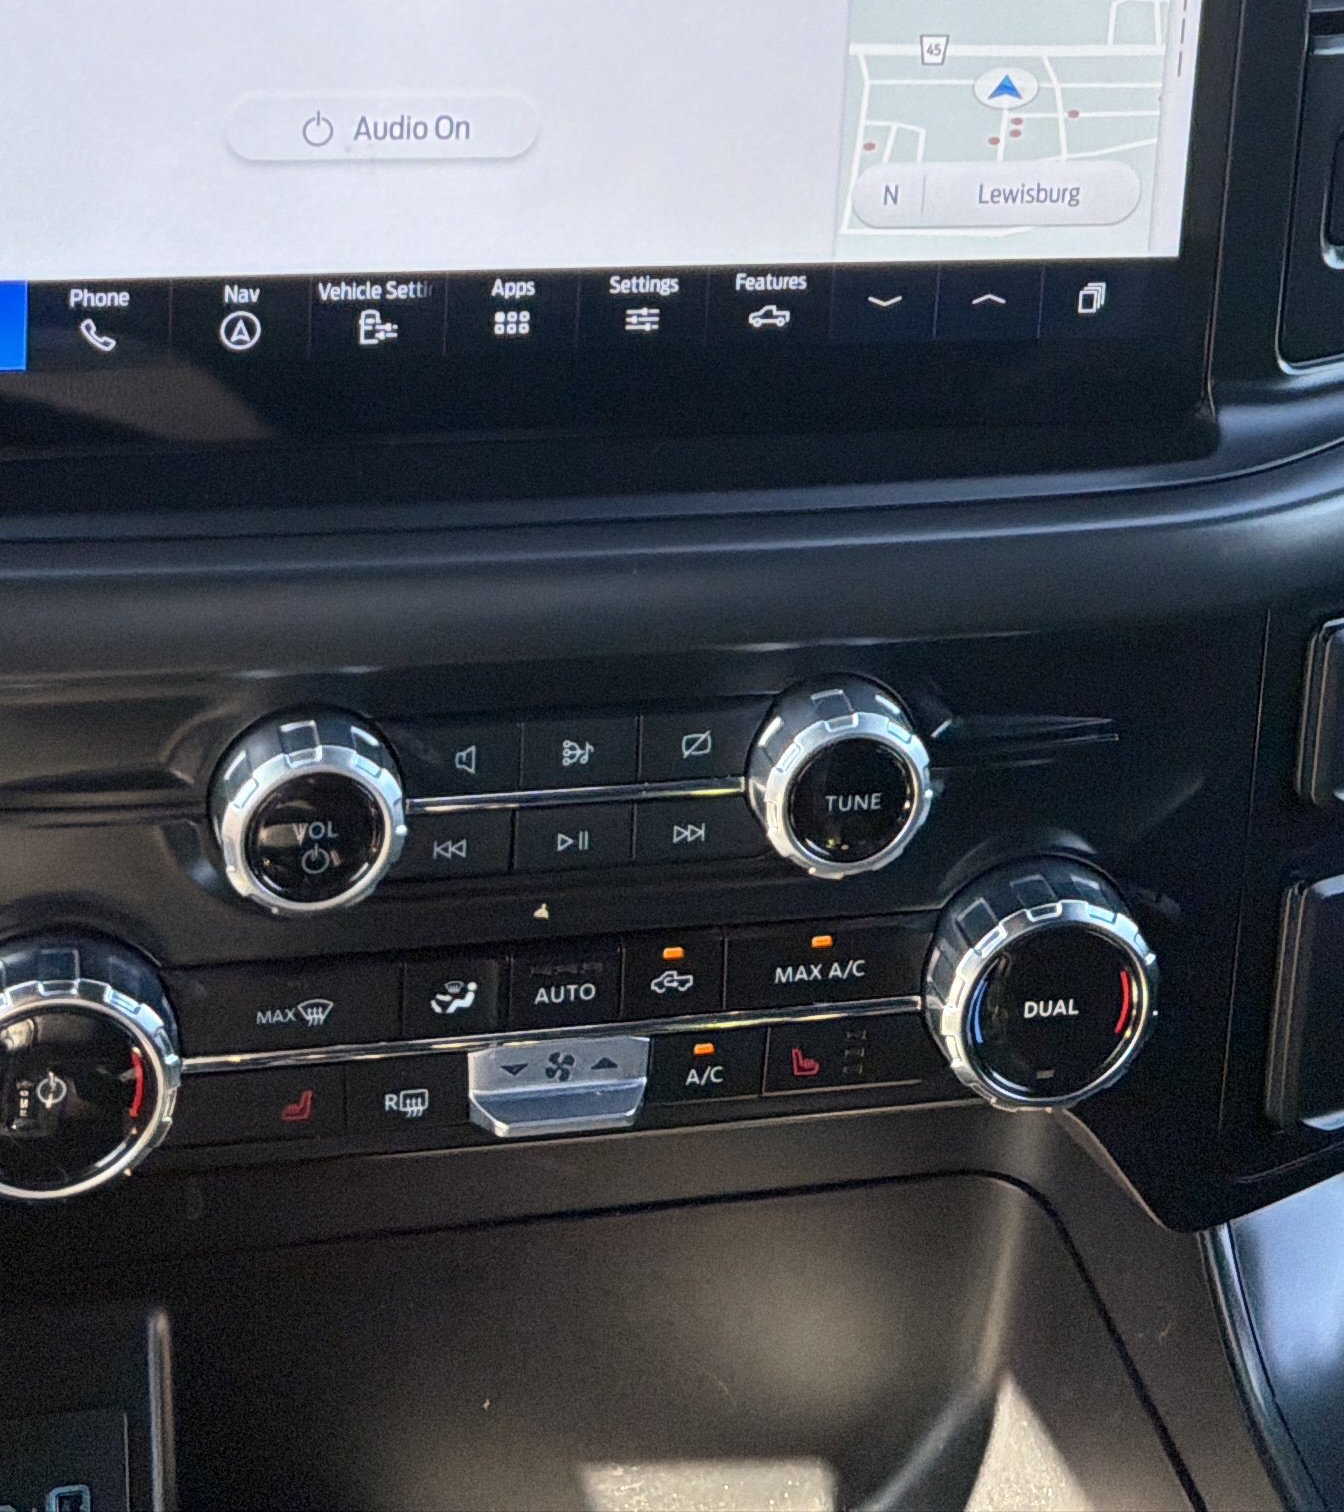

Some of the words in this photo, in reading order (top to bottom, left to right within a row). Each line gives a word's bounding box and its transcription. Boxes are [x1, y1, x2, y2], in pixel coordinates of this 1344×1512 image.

[925, 42, 942, 57] 45
[353, 114, 429, 141] Audio
[434, 114, 470, 140] On
[882, 184, 899, 206] N
[977, 182, 1081, 208] Lewisburg
[317, 279, 382, 300] Vehicle
[491, 279, 535, 300] Apps
[609, 274, 679, 297] Settings
[735, 271, 807, 293] Features
[68, 287, 130, 309] Phone
[222, 284, 260, 305] Nav
[824, 791, 883, 814] TUNE
[291, 820, 338, 842] VOL
[773, 963, 823, 984] MAX
[828, 958, 866, 980] A/C
[533, 982, 596, 1006] AUTO
[255, 1006, 296, 1025] MAX
[1022, 997, 1080, 1019] DUAL
[684, 1065, 724, 1087] A/C
